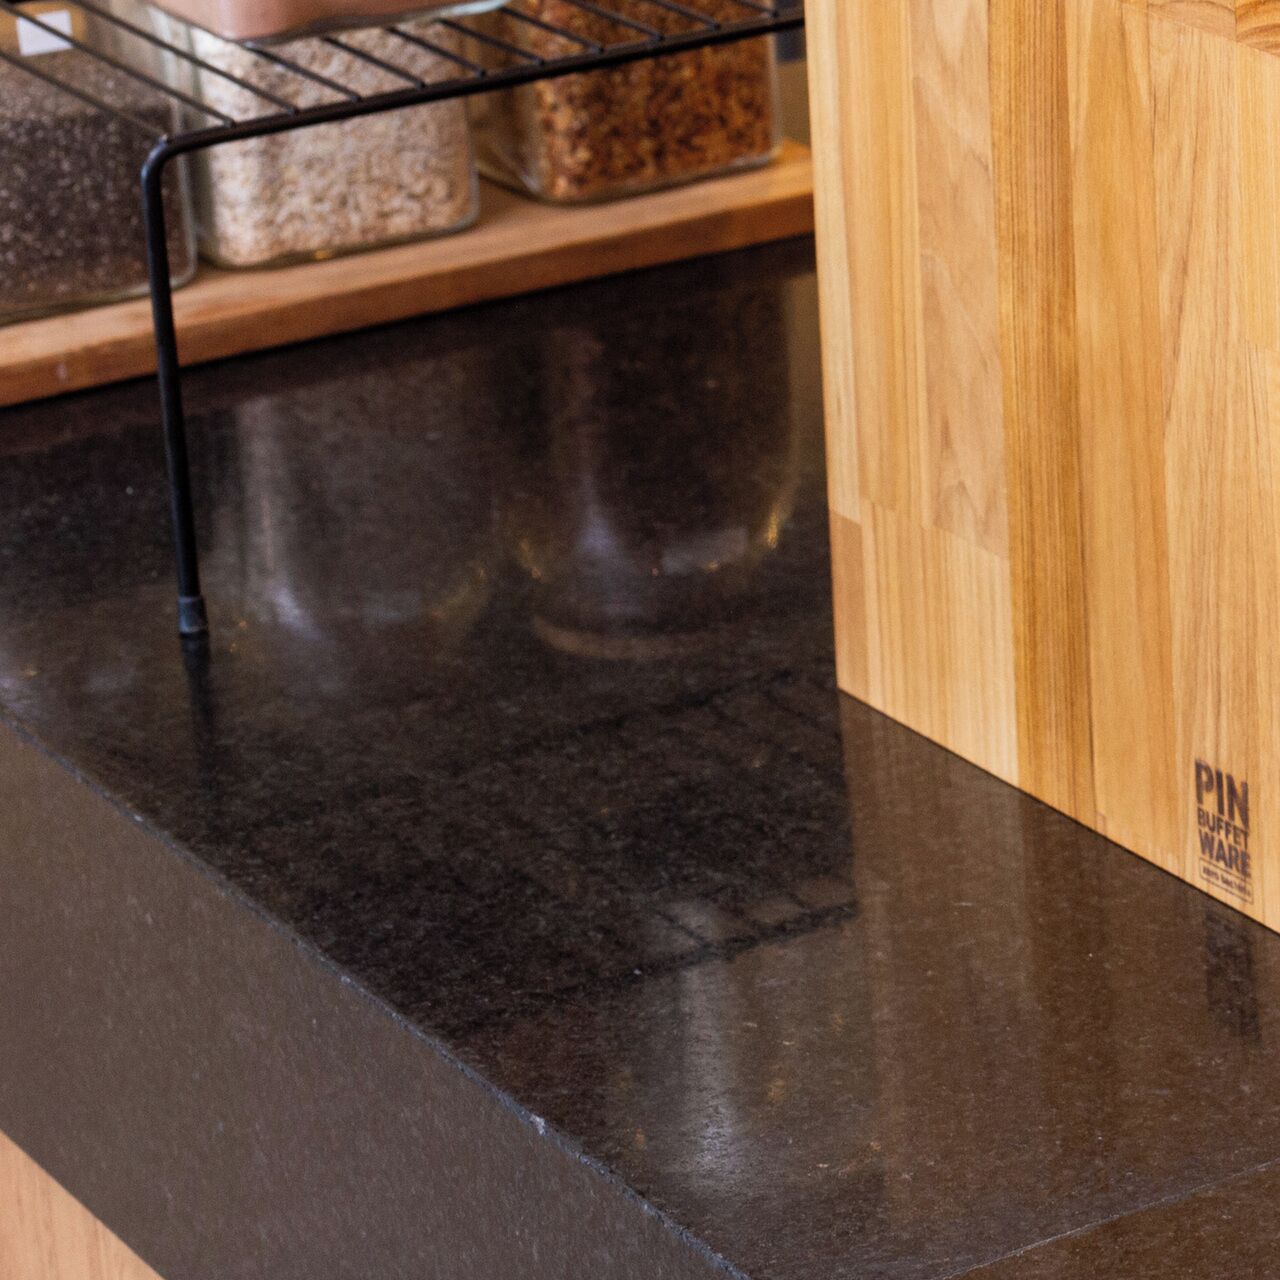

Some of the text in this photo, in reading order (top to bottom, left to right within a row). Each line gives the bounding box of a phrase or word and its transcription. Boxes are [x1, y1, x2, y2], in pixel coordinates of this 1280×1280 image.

[1194, 757, 1249, 829] PIN
[1197, 806, 1249, 849] BUFFET
[1198, 828, 1251, 878] WARE
